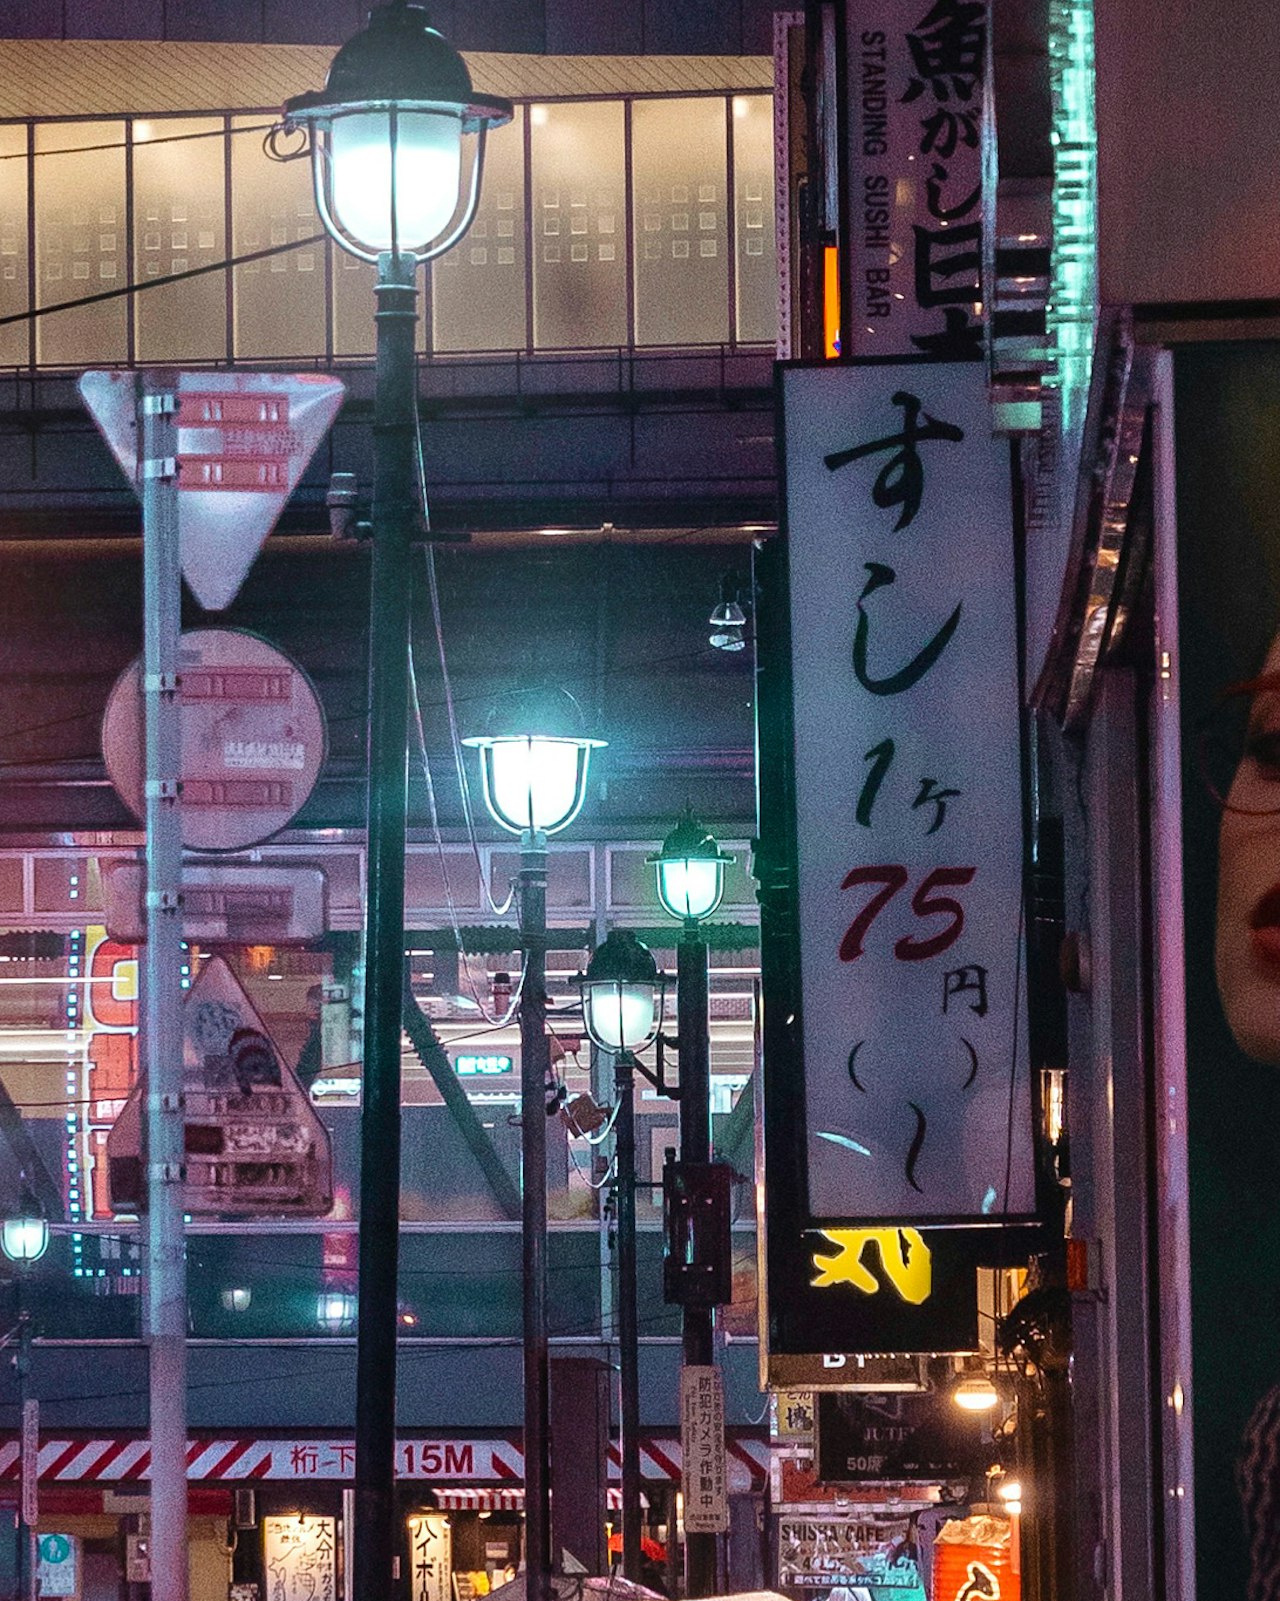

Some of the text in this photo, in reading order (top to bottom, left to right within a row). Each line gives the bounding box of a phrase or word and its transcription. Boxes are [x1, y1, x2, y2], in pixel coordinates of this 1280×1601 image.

[860, 29, 891, 319] STANDING SUSHI BAR
[823, 389, 966, 699] すし
[698, 1376, 713, 1509] 防犯カメラ作動中
[845, 1523, 885, 1543] CAFE
